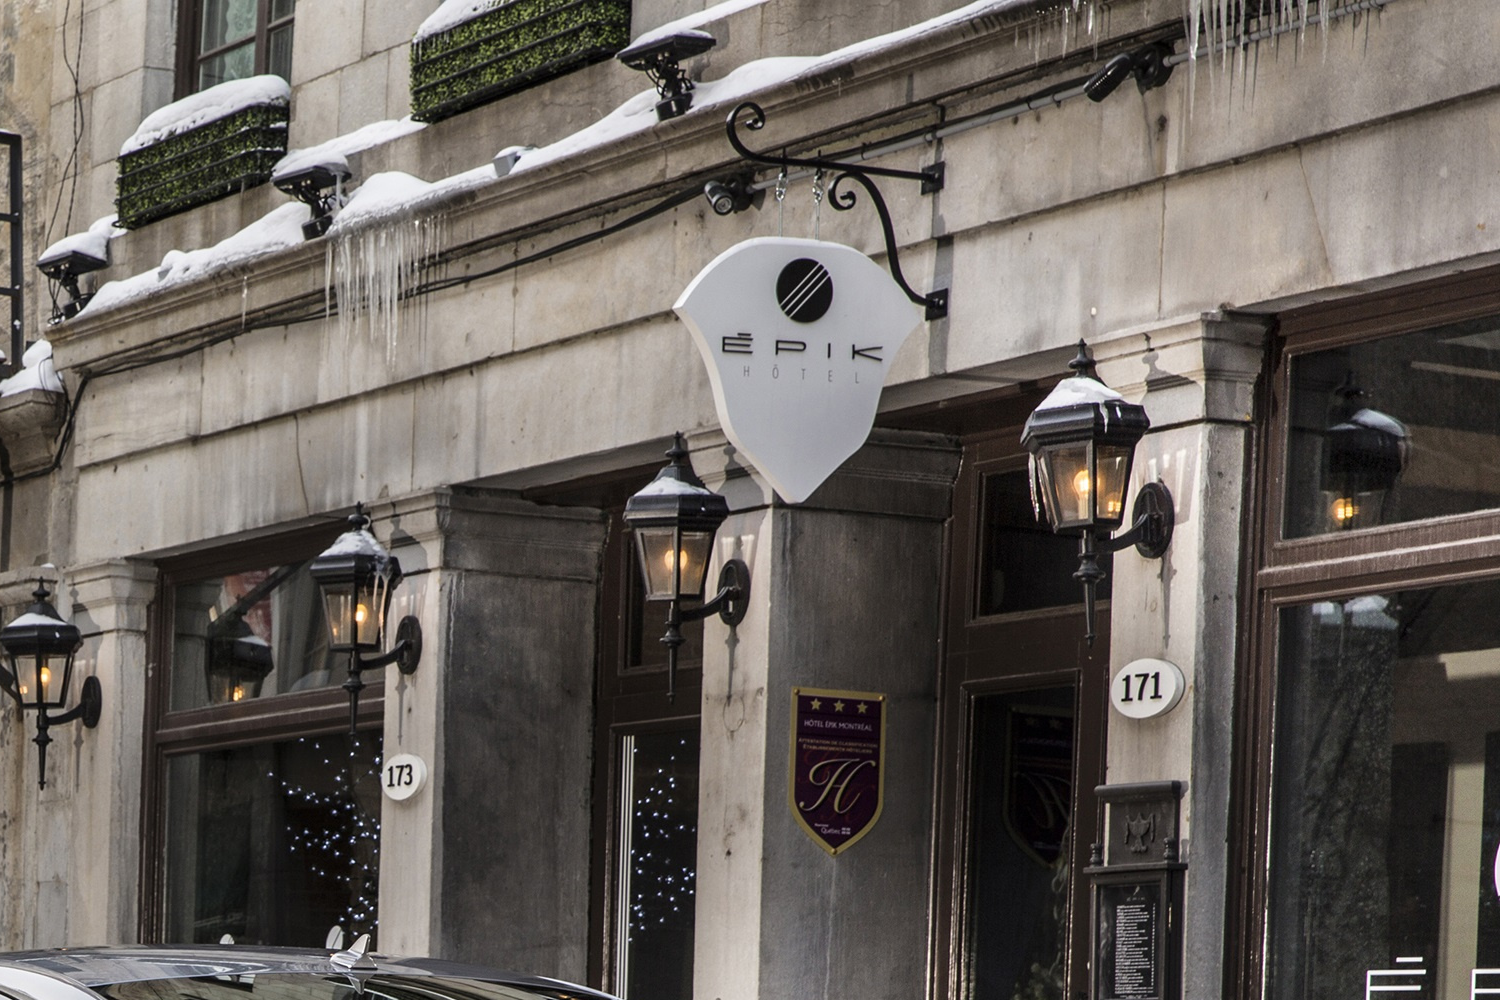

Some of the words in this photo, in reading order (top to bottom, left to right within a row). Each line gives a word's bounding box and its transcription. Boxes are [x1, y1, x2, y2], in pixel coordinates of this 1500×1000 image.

[722, 332, 883, 362] ÉPIK
[743, 364, 860, 384] HÔTEL
[1120, 671, 1163, 702] 171
[803, 718, 824, 728] HÔTEL
[838, 722, 873, 732] MONTRÉAL
[387, 764, 413, 788] 173
[799, 758, 877, 815] H
